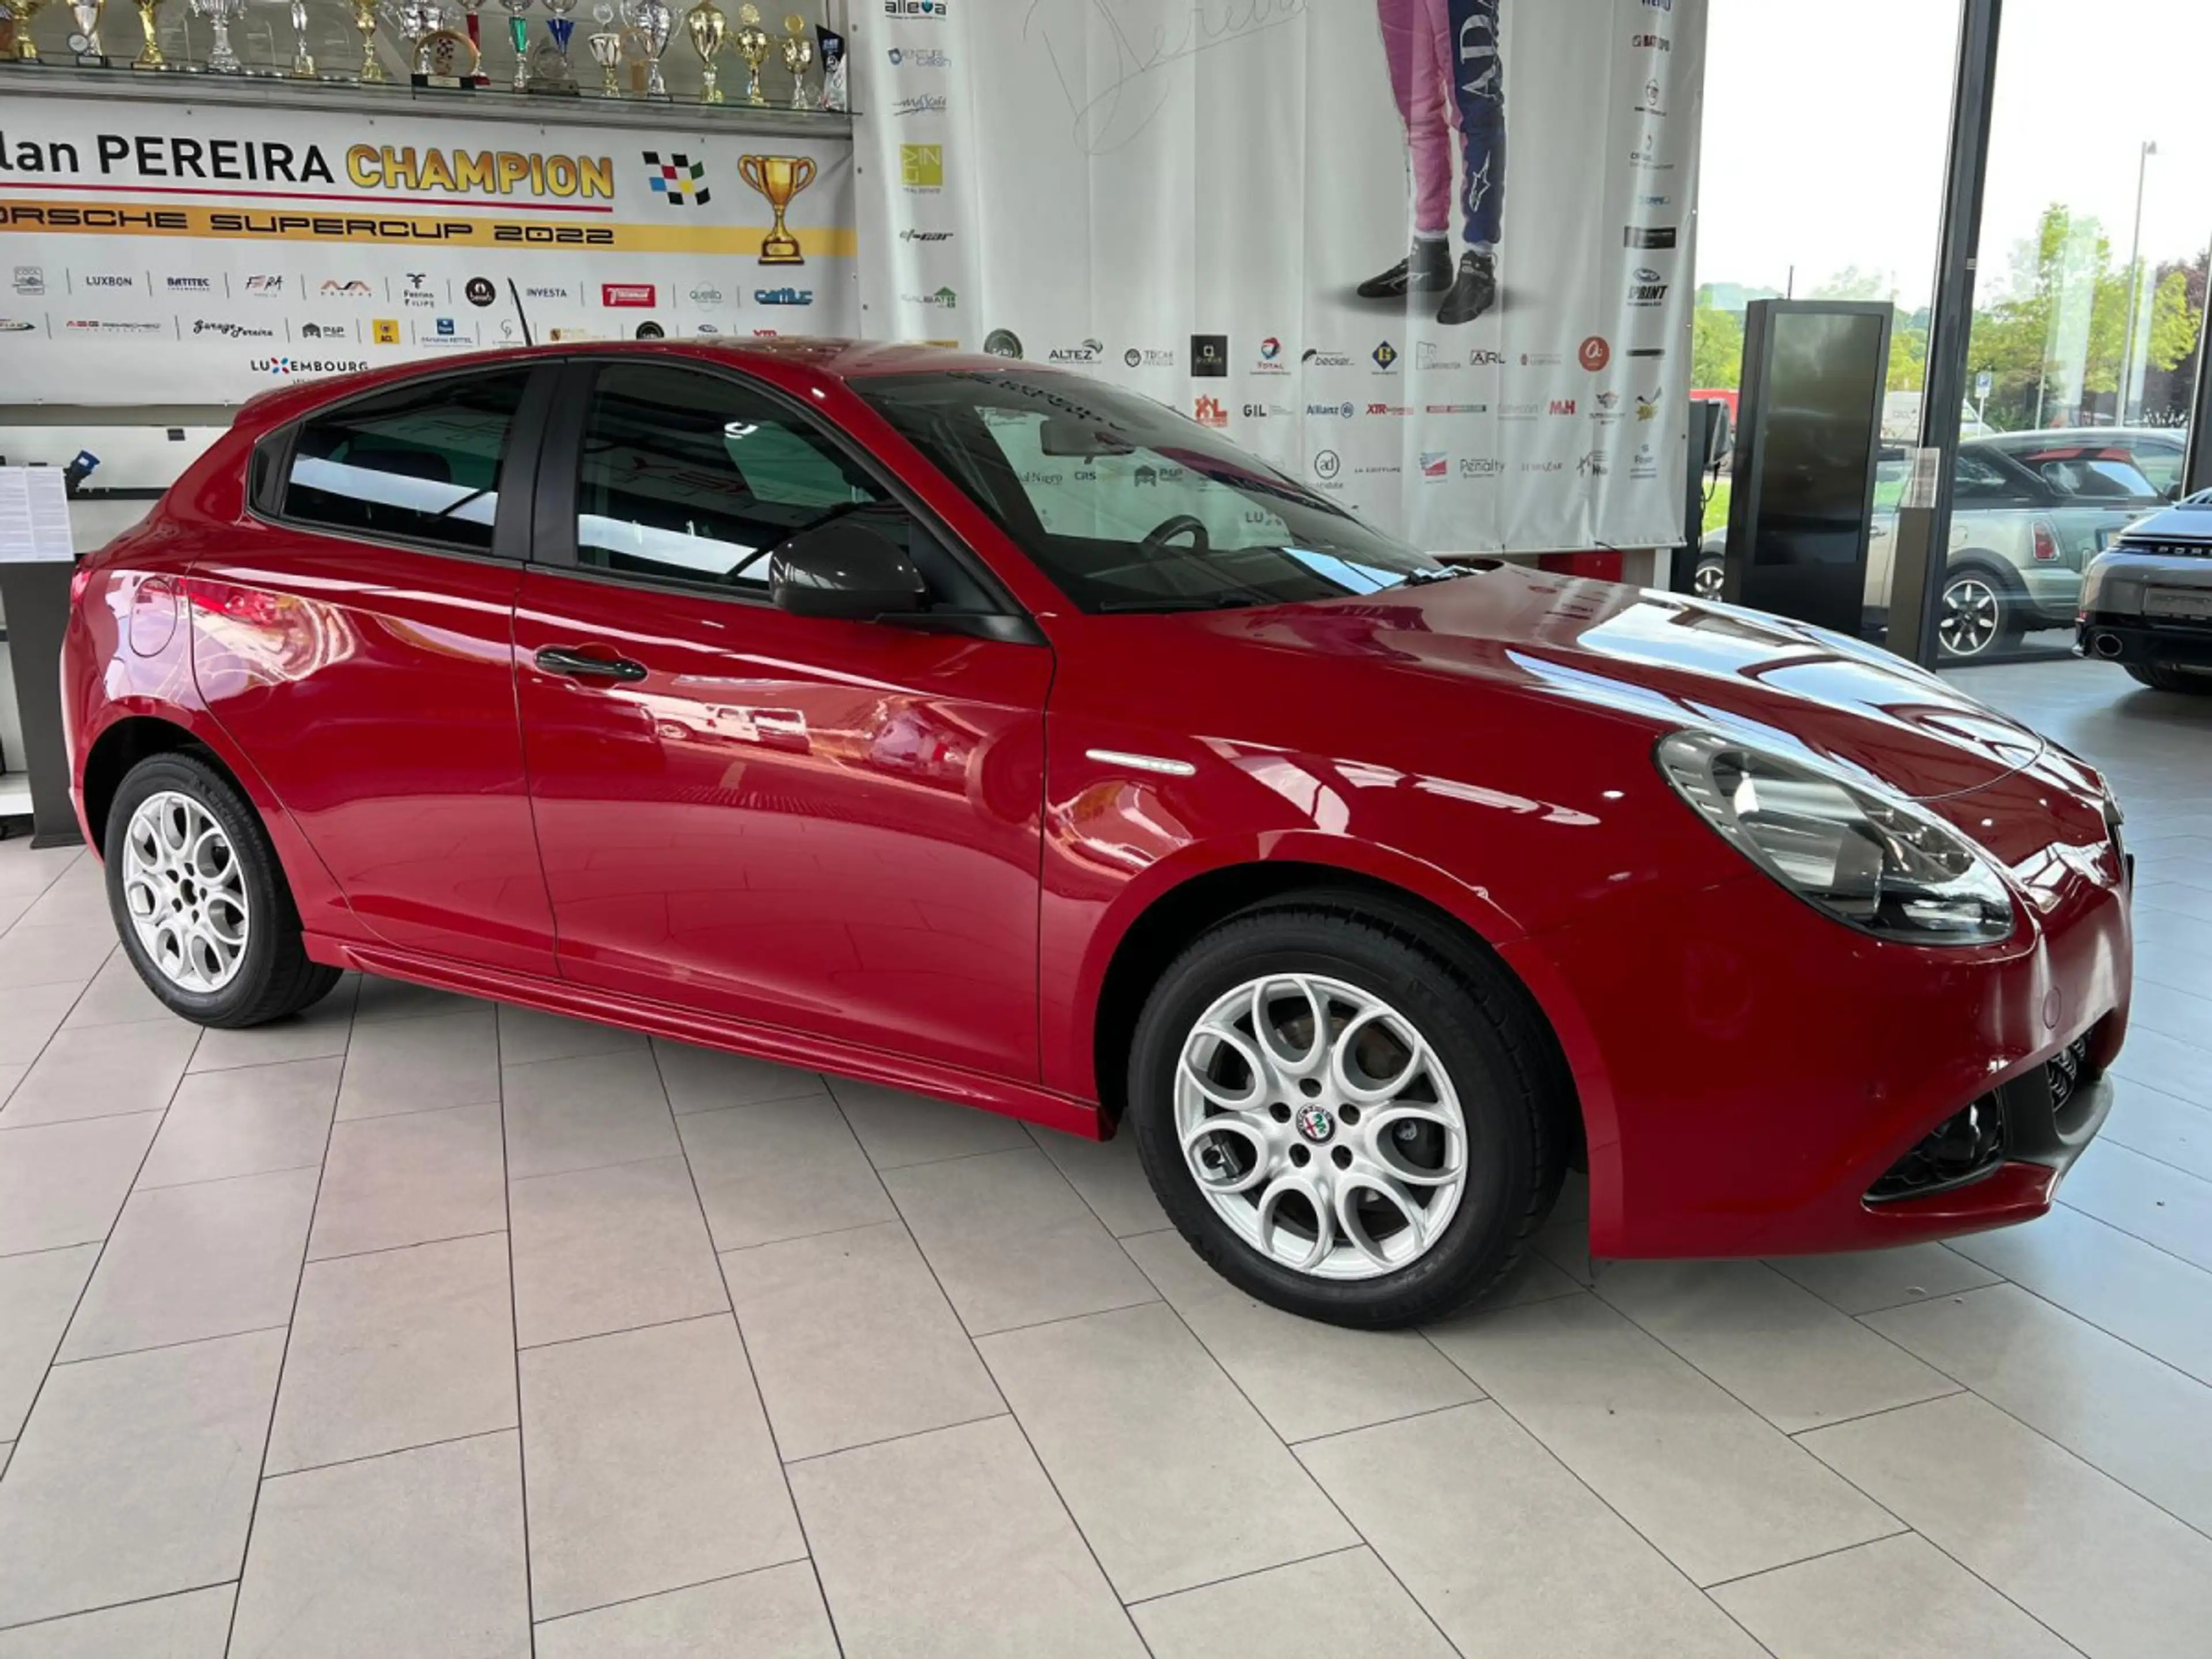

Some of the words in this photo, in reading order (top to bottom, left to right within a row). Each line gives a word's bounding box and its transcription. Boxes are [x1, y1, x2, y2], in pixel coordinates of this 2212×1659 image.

[97, 134, 335, 184] PEREIRA
[346, 143, 615, 199] CHAMPION
[0, 206, 188, 229] RSCHE
[210, 214, 473, 238] SUPERCUP
[494, 225, 614, 244] 2022
[86, 276, 132, 286] LUXBON
[1049, 350, 1093, 360] ALTEZ
[1243, 404, 1267, 418] GIL
